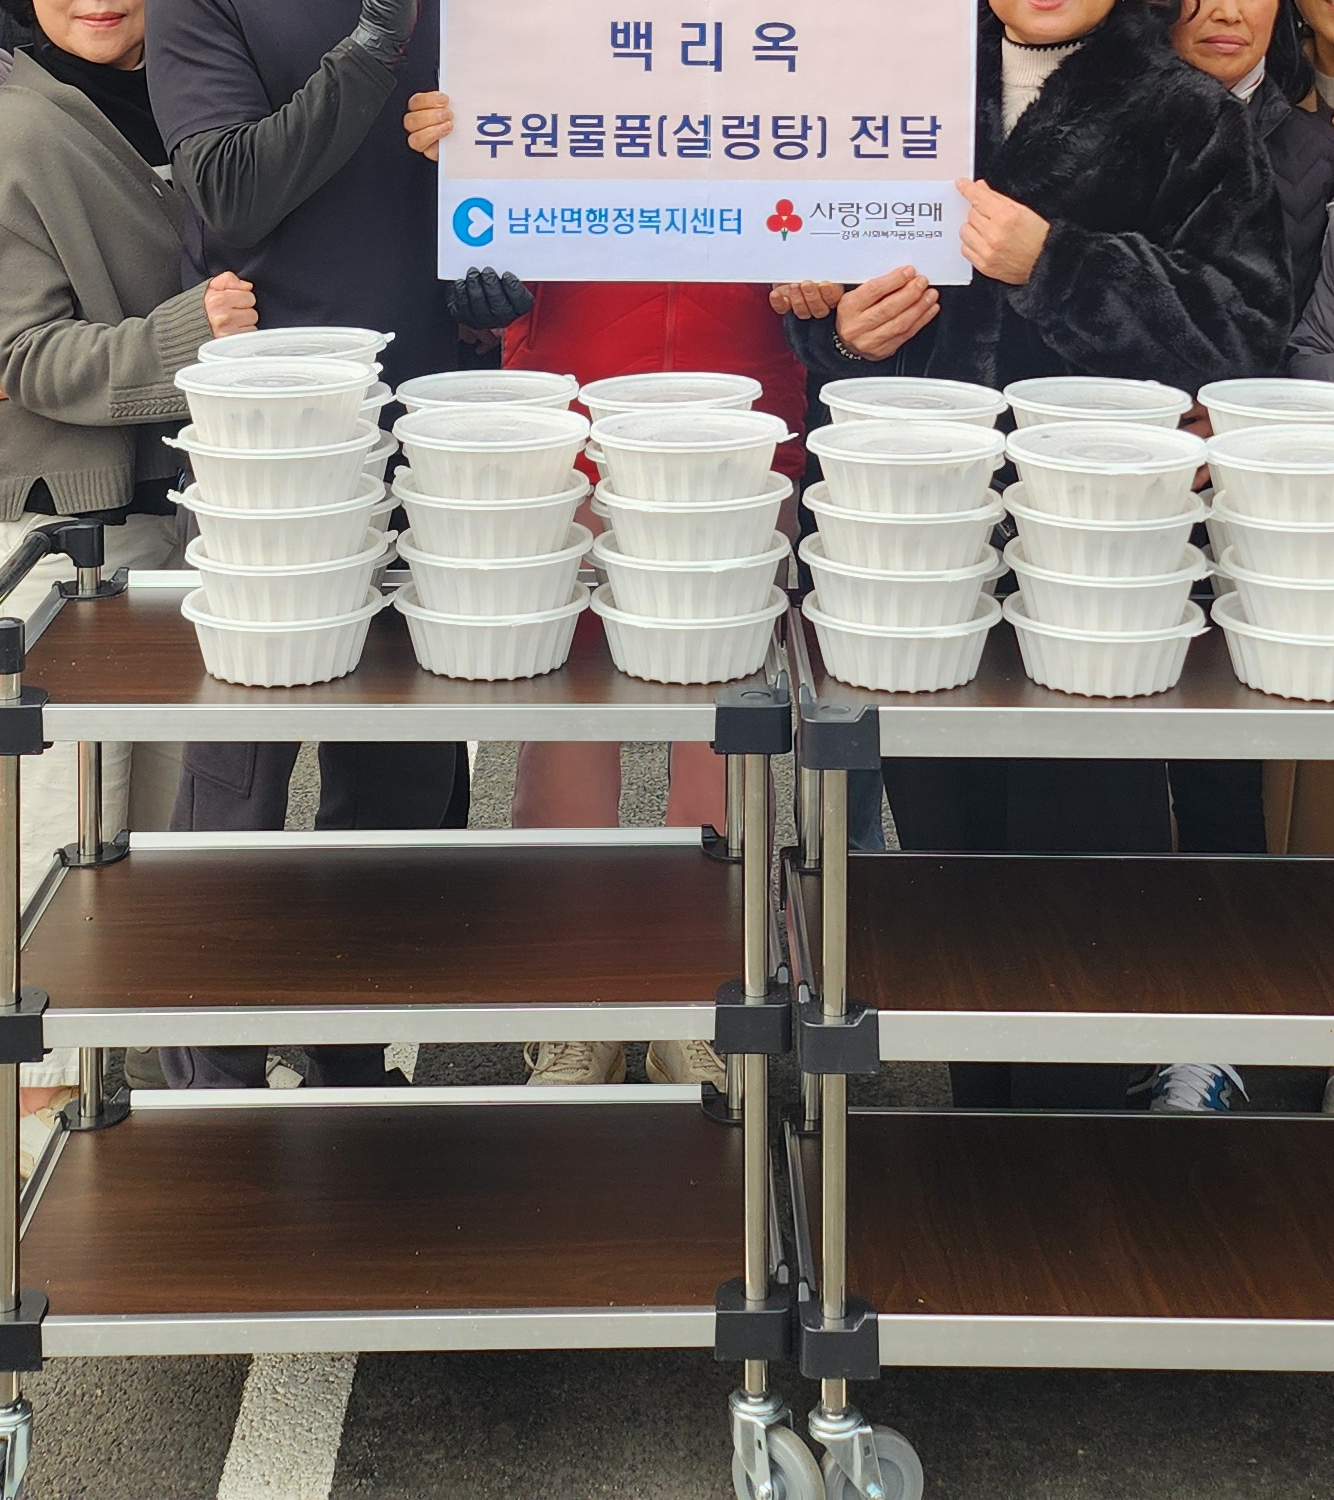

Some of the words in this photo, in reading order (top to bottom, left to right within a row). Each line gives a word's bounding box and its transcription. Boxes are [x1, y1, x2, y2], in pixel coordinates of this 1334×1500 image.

[473, 112, 828, 161] 후원물품(설렁탕)
[848, 113, 942, 161] 전달
[507, 206, 743, 236] 남산면행정복지센터
[809, 201, 943, 228] 사랑의열매
